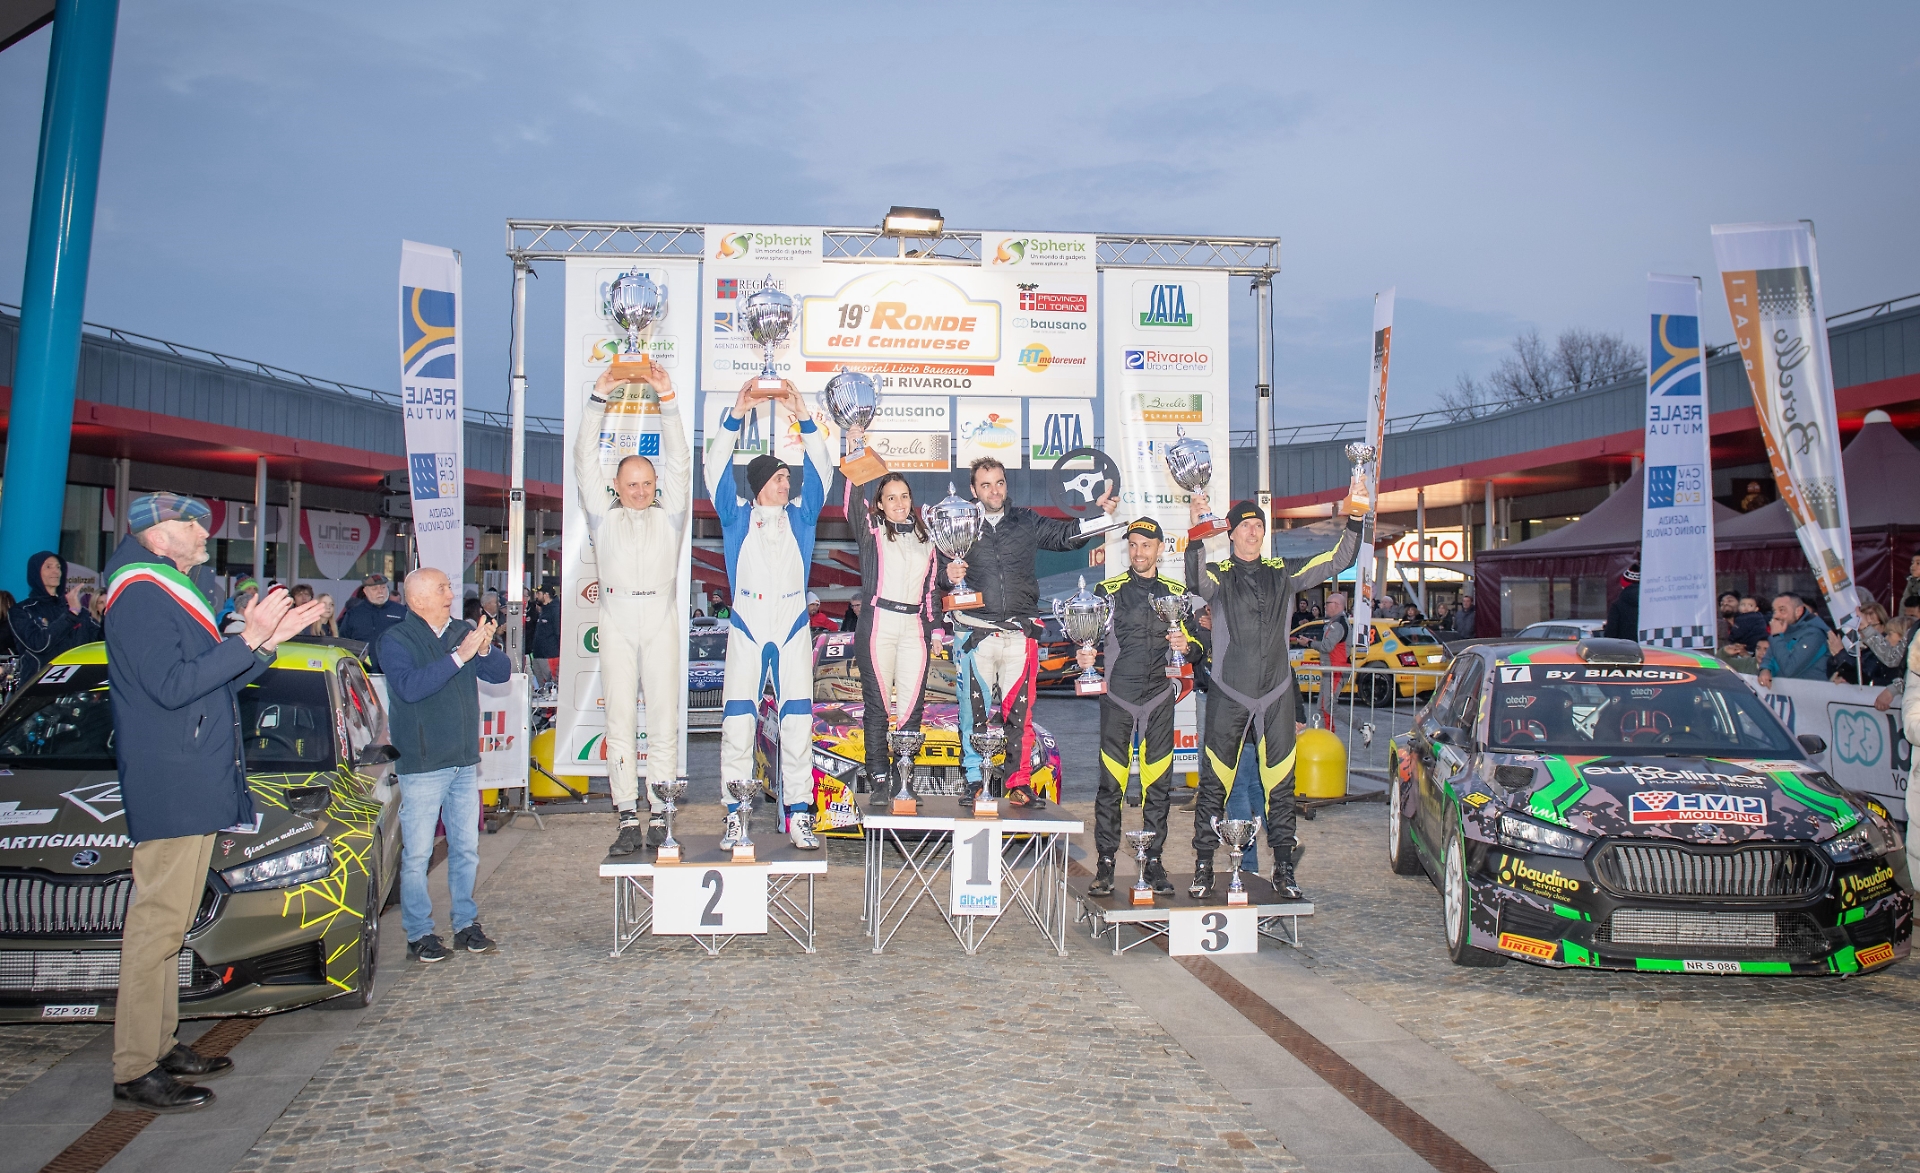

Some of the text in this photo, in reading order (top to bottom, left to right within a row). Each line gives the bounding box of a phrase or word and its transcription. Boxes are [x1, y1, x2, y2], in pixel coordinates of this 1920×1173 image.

[755, 233, 811, 247] Spherix
[1031, 238, 1085, 253] Spherix
[1038, 295, 1084, 303] PROVINCIA
[1146, 284, 1187, 323] SATA
[1031, 318, 1087, 330] bausano
[828, 334, 970, 350] del Canavese
[733, 360, 791, 370] bausno
[1018, 349, 1087, 365] RT motorevent
[1147, 350, 1208, 364] Rivarolo
[891, 363, 919, 374] Livio
[923, 364, 969, 376] Bausano
[1147, 363, 1207, 371] Urban Center
[882, 377, 972, 389] di RIVAROLO
[1039, 413, 1085, 456] SATA
[878, 437, 927, 457] Borello
[318, 521, 360, 542] unica
[829, 646, 840, 656] 3
[45, 666, 66, 682] 4
[1506, 667, 1683, 681] 7 By BIANCHI
[1582, 765, 1666, 775] euro
[1632, 770, 1767, 786] polimer
[1694, 780, 1767, 790] DISTRIBUTION
[1678, 794, 1758, 813] EMP
[1679, 811, 1760, 823] MOULDING
[0, 833, 136, 849] ARTIGIANAM
[244, 843, 266, 859] Gian
[963, 828, 992, 886] 1
[1517, 859, 1580, 892] baudino
[1855, 866, 1893, 891] baudino
[1522, 883, 1571, 903] Your quality choice
[1532, 881, 1562, 894] service
[700, 869, 725, 927] 2
[1201, 911, 1229, 953] 3
[1501, 934, 1557, 957] PIRELLI
[1857, 943, 1892, 966] PIRELLI
[1686, 961, 1737, 971] NR S 086
[45, 1007, 96, 1016] SZP 98E
